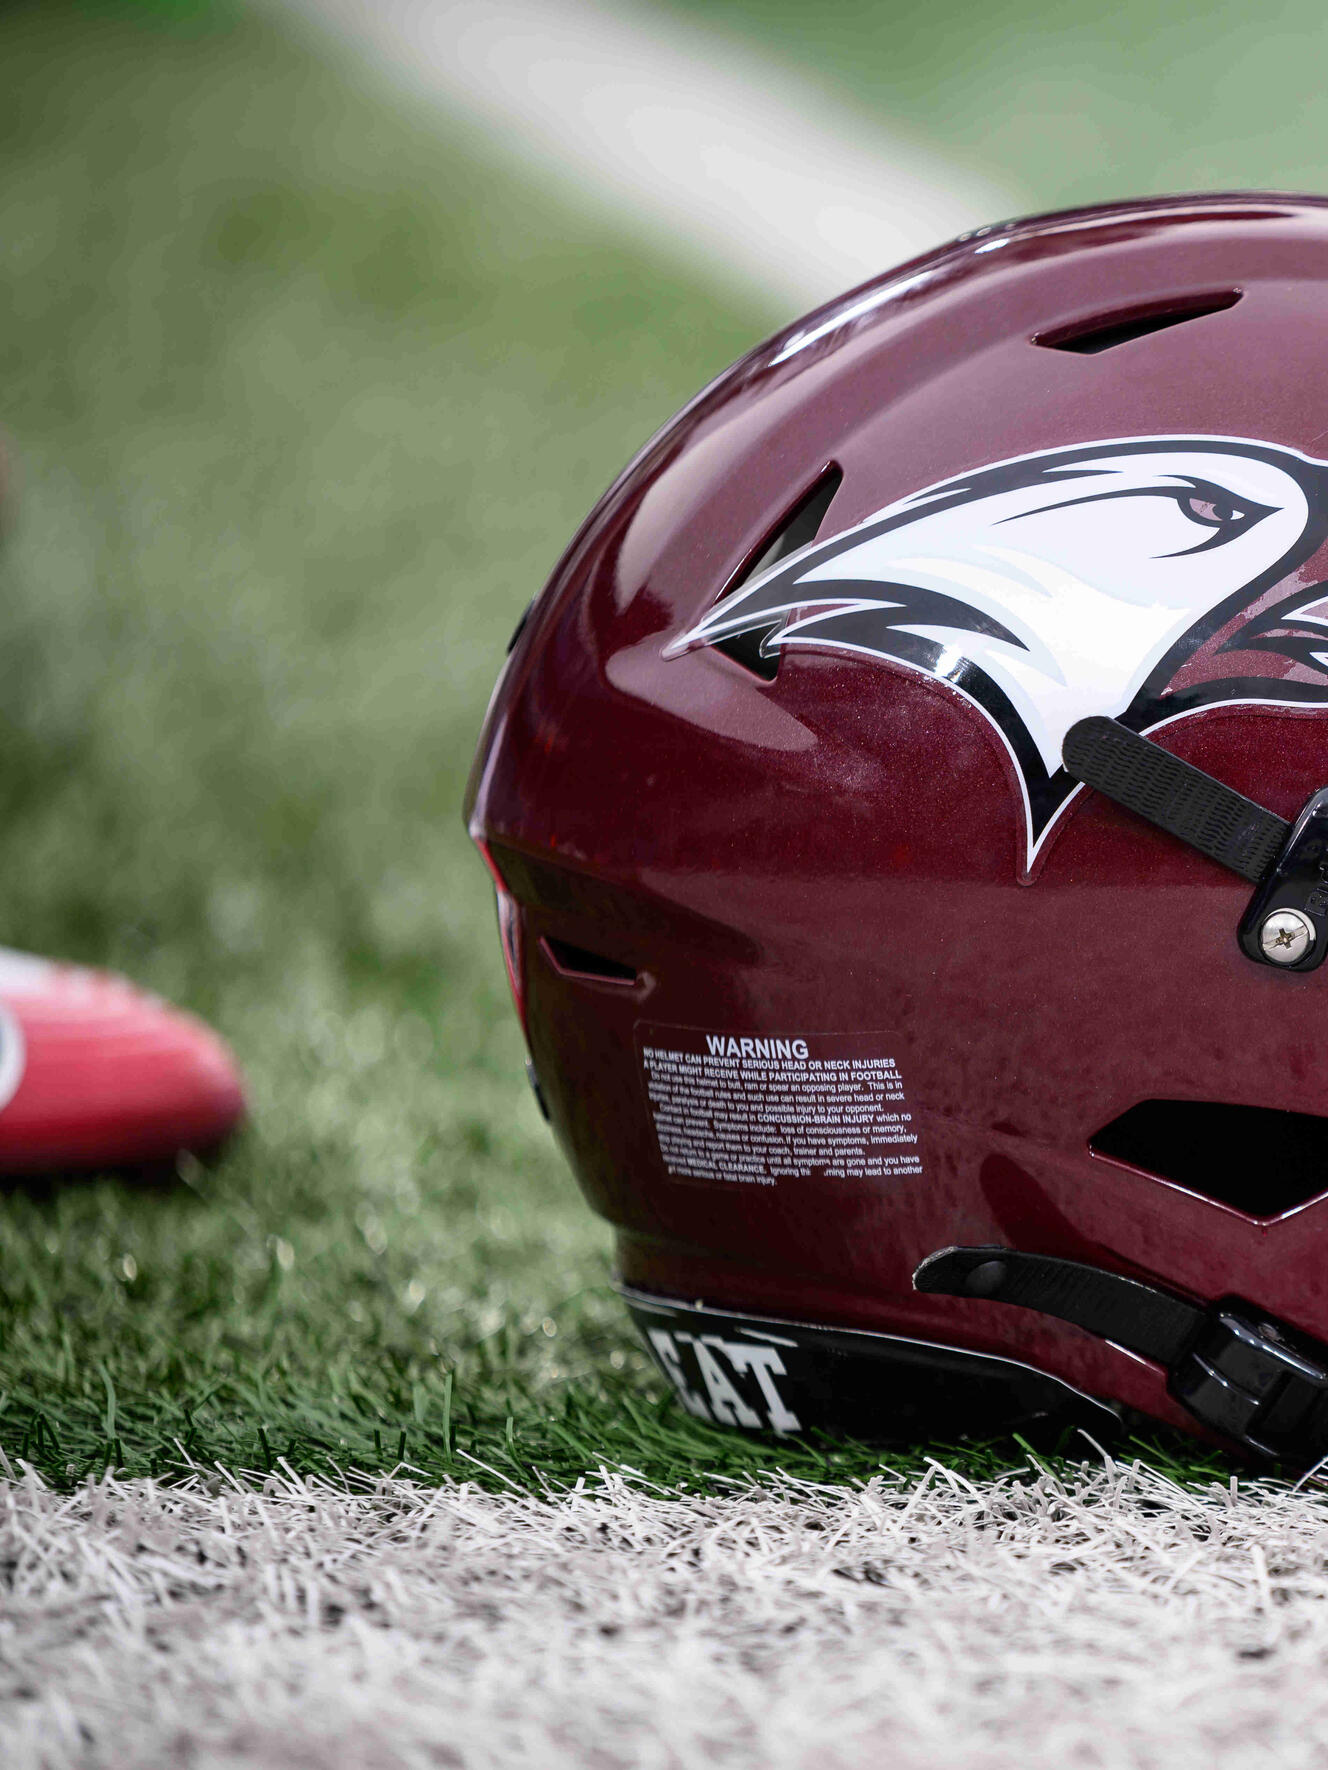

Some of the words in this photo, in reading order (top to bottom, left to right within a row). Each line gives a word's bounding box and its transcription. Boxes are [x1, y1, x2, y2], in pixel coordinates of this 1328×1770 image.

[706, 1034, 809, 1060] WARNING
[654, 1048, 683, 1061] HELMET
[684, 1052, 701, 1064] CAN
[702, 1054, 740, 1068] PREVENT
[742, 1059, 780, 1070] SERIOUS
[781, 1061, 807, 1070] HEAD
[808, 1061, 823, 1070] OR
[823, 1060, 851, 1070] NECK
[851, 1058, 896, 1070] INJURIES
[649, 1060, 678, 1073] PLAYER
[678, 1063, 703, 1076] MIGHT
[703, 1066, 739, 1079] RECEIVE
[740, 1070, 768, 1081] WHILE
[768, 1072, 837, 1082] PARTICIPATING
[839, 1072, 849, 1081] IN
[719, 1079, 727, 1088] to
[727, 1080, 743, 1090] butt,
[744, 1082, 759, 1091] ram
[759, 1083, 767, 1091] or
[768, 1083, 789, 1093] spear
[801, 1082, 837, 1094] opposing
[837, 1081, 864, 1094] player.
[866, 1080, 885, 1090] This
[886, 1080, 894, 1090] is
[895, 1080, 903, 1089] in
[732, 1091, 746, 1101] and
[747, 1093, 764, 1101] such
[795, 1094, 816, 1102] result
[817, 1094, 825, 1102] in
[826, 1094, 853, 1102] severe
[853, 1093, 874, 1102] head
[875, 1093, 884, 1101] or
[885, 1092, 905, 1101] neck
[727, 1101, 735, 1110] to
[736, 1103, 749, 1113] you
[750, 1102, 764, 1111] and
[764, 1103, 795, 1115] possible
[796, 1105, 816, 1115] injury
[817, 1105, 825, 1113] to
[826, 1105, 843, 1115] your
[845, 1103, 884, 1115] opponent.
[749, 1113, 756, 1121] in
[757, 1113, 840, 1123] CONCUSSION-BRAIN
[842, 1114, 874, 1123] INJURY
[876, 1113, 900, 1122] which
[901, 1113, 912, 1121] no
[713, 1120, 749, 1133] Symptoms
[780, 1125, 796, 1134] loss
[796, 1125, 804, 1134] of
[805, 1126, 861, 1134] consciousness
[862, 1126, 871, 1134] or
[872, 1125, 907, 1135] memory,
[785, 1136, 791, 1144] If
[792, 1137, 806, 1147] you
[807, 1136, 826, 1145] have
[827, 1135, 869, 1147] symptoms,
[870, 1133, 918, 1146] immediately
[752, 1146, 767, 1155] your
[768, 1146, 792, 1155] coach,
[793, 1147, 817, 1155] trainer
[818, 1147, 833, 1155] and
[834, 1147, 866, 1158] parents.
[783, 1156, 792, 1165] all
[846, 1158, 866, 1168] gone
[867, 1156, 882, 1166] and
[883, 1157, 899, 1167] you
[899, 1155, 920, 1164] have
[770, 1165, 800, 1178] Ignoring
[823, 1167, 846, 1178] rning
[846, 1168, 864, 1178] may
[864, 1166, 882, 1176] lead
[883, 1166, 892, 1175] to
[893, 1165, 923, 1175] another
